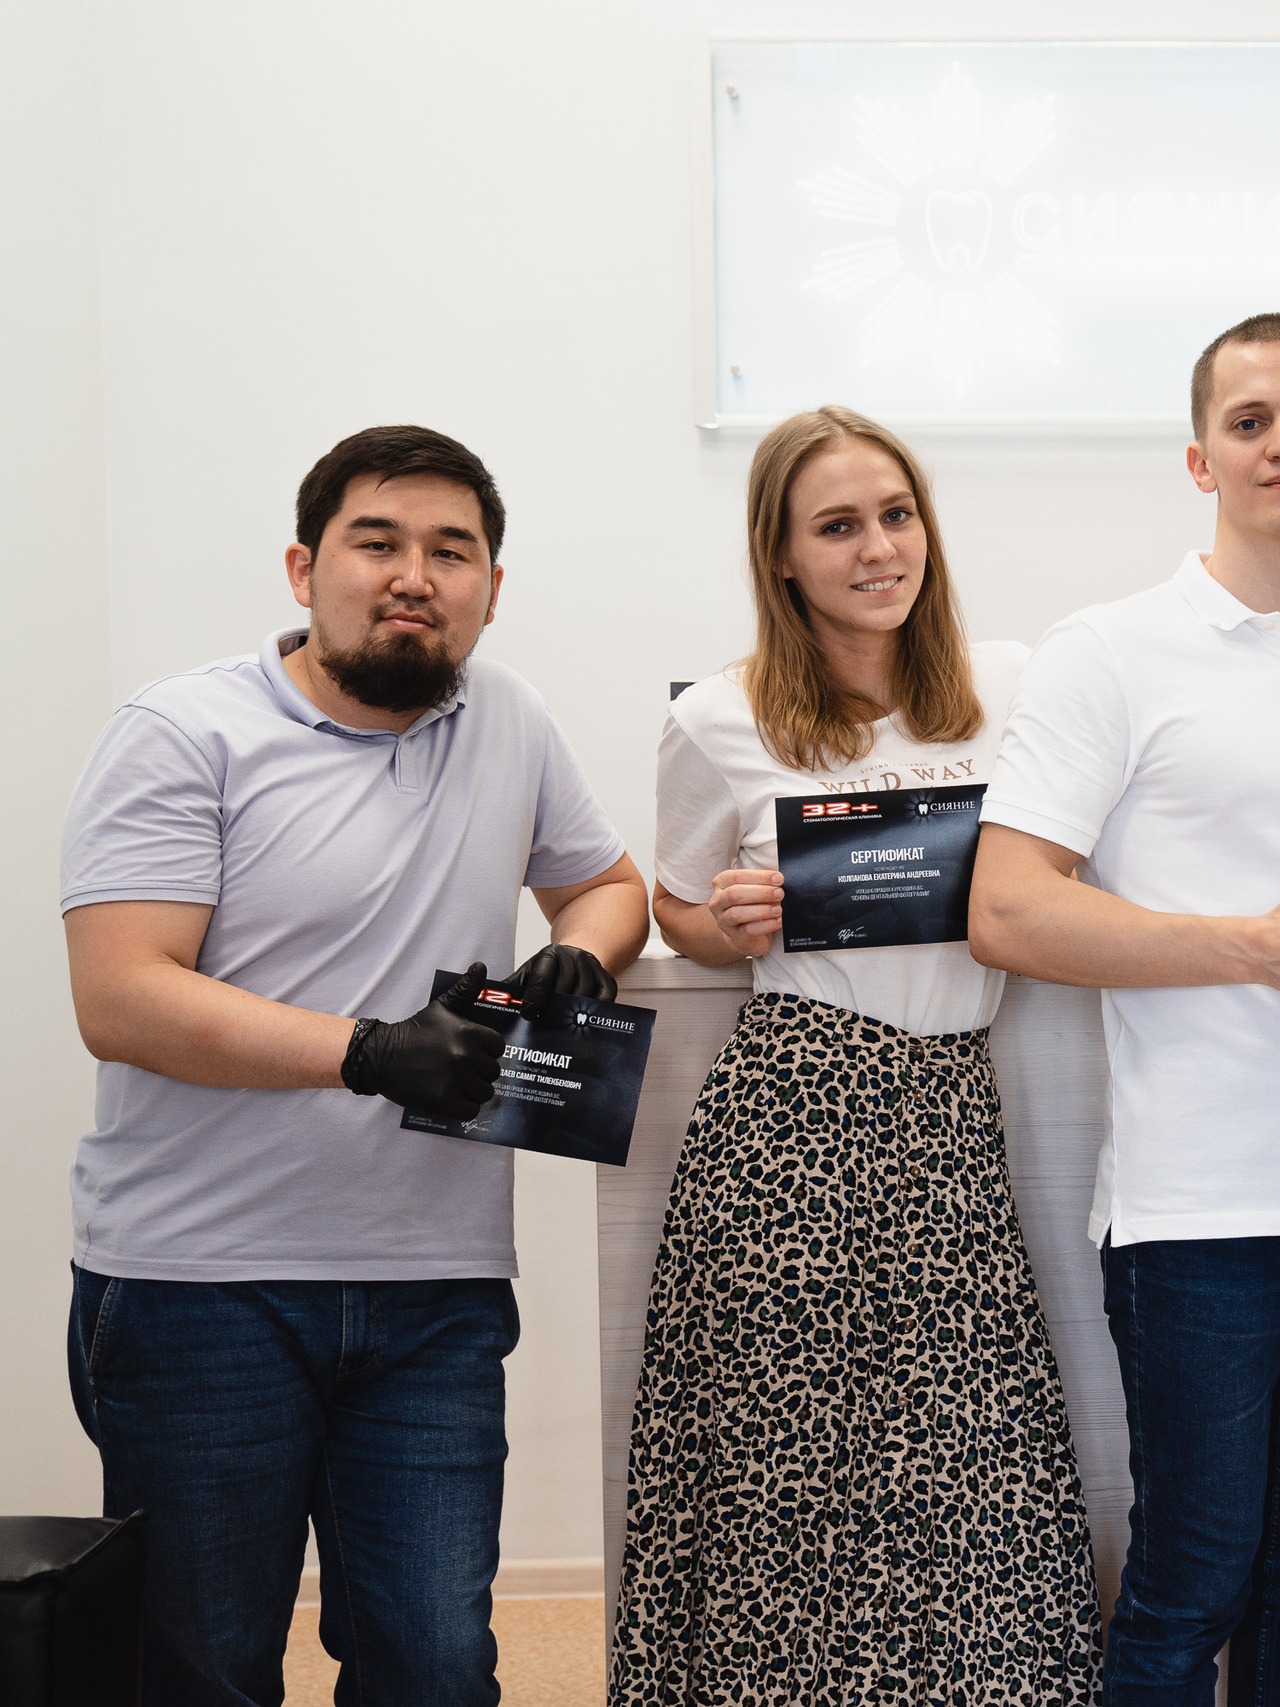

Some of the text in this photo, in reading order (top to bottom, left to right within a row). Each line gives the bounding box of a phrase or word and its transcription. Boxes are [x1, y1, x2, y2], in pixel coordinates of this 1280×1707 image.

[818, 759, 976, 794] WILD WAY
[802, 801, 878, 817] 32+
[930, 800, 976, 811] СИЯНИЕ
[803, 815, 858, 823] СТОМАТОЛОГИЧЕСКАЯ
[850, 847, 925, 864] СЕРТИФИКАТ
[838, 869, 940, 883] КОЛПАКОВА ЕКАТЕРИНА АНДРЕЕВНА
[588, 1014, 635, 1032] СИЯНИЕ
[502, 1044, 572, 1069] ЕРТИФИКАТ
[516, 1071, 536, 1082] САМАТ
[537, 1075, 582, 1090] ТИЛЕКБЕКОВИЧ
